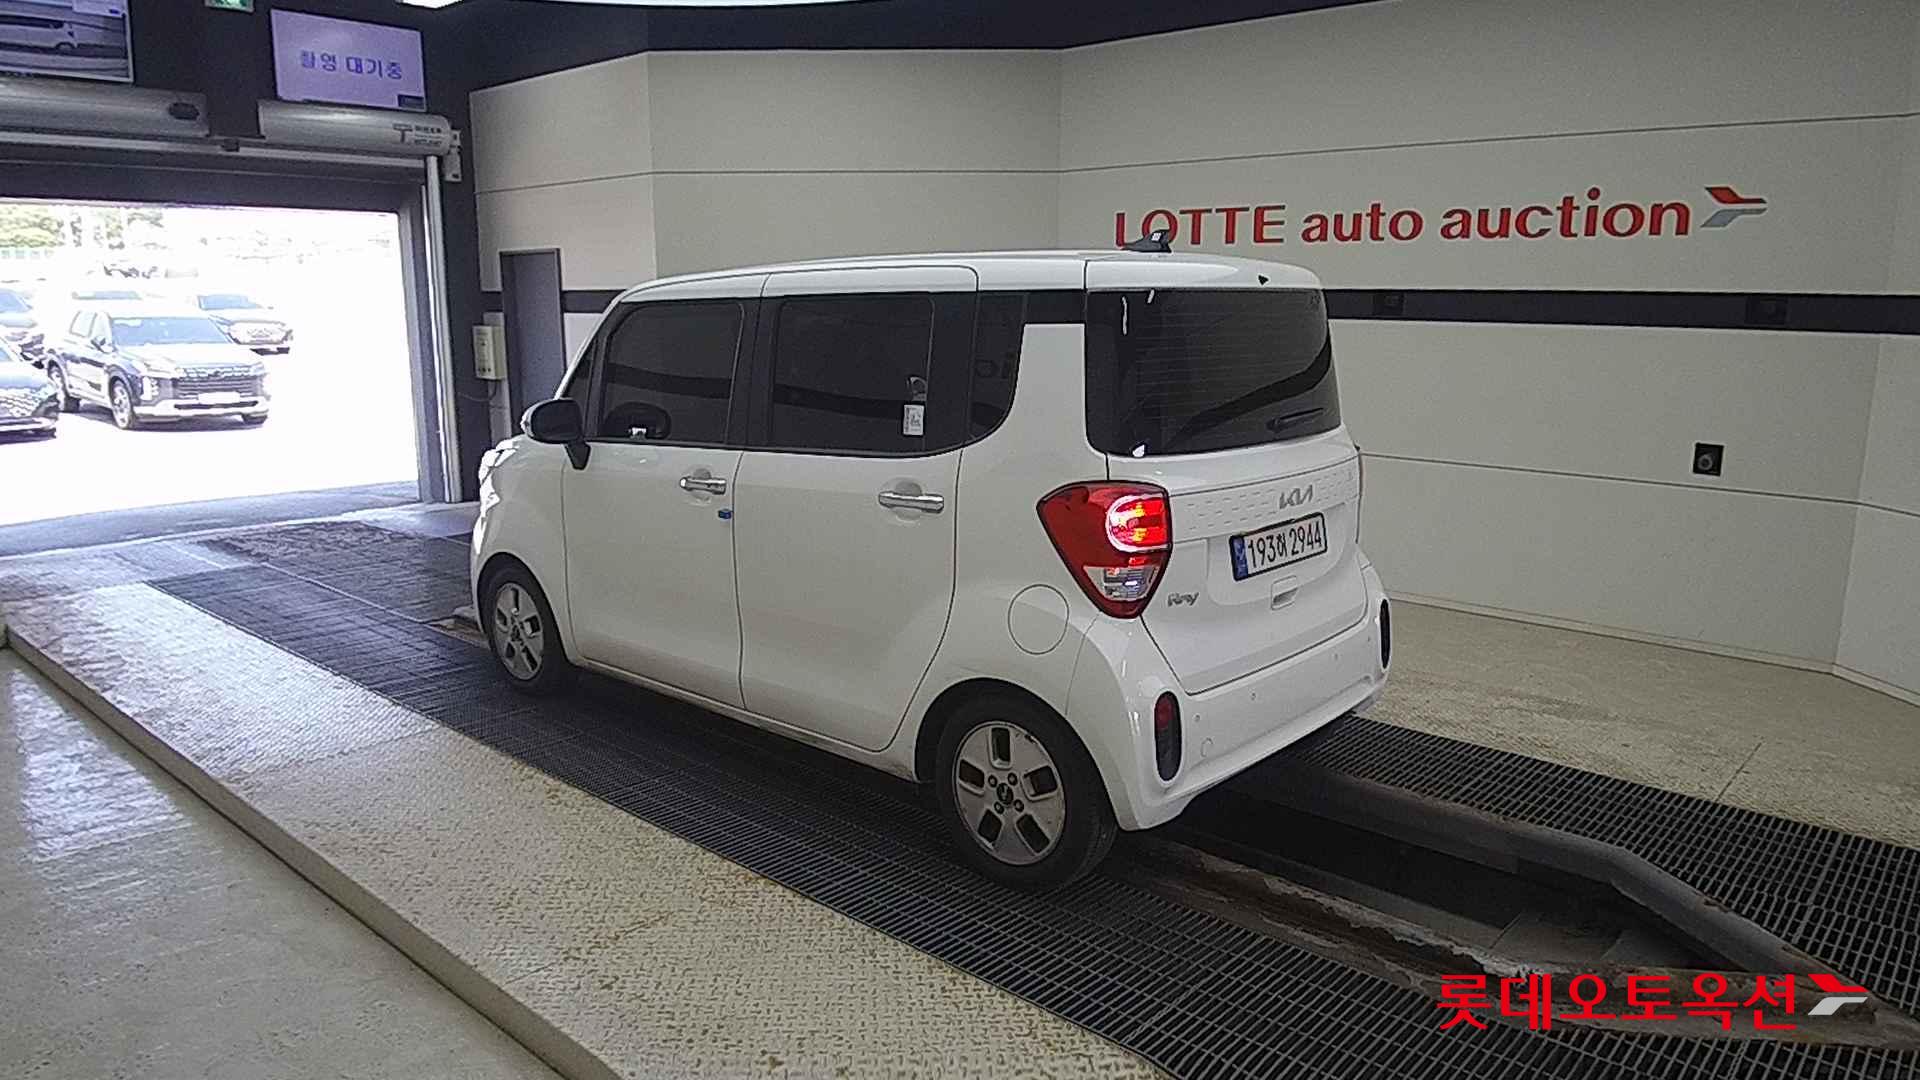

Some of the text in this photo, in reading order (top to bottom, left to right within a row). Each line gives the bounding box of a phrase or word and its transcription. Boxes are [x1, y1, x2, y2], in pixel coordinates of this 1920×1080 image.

[346, 56, 402, 80] 대기중
[1116, 187, 1690, 247] LOTTE auto auction
[1288, 520, 1323, 556] 2944
